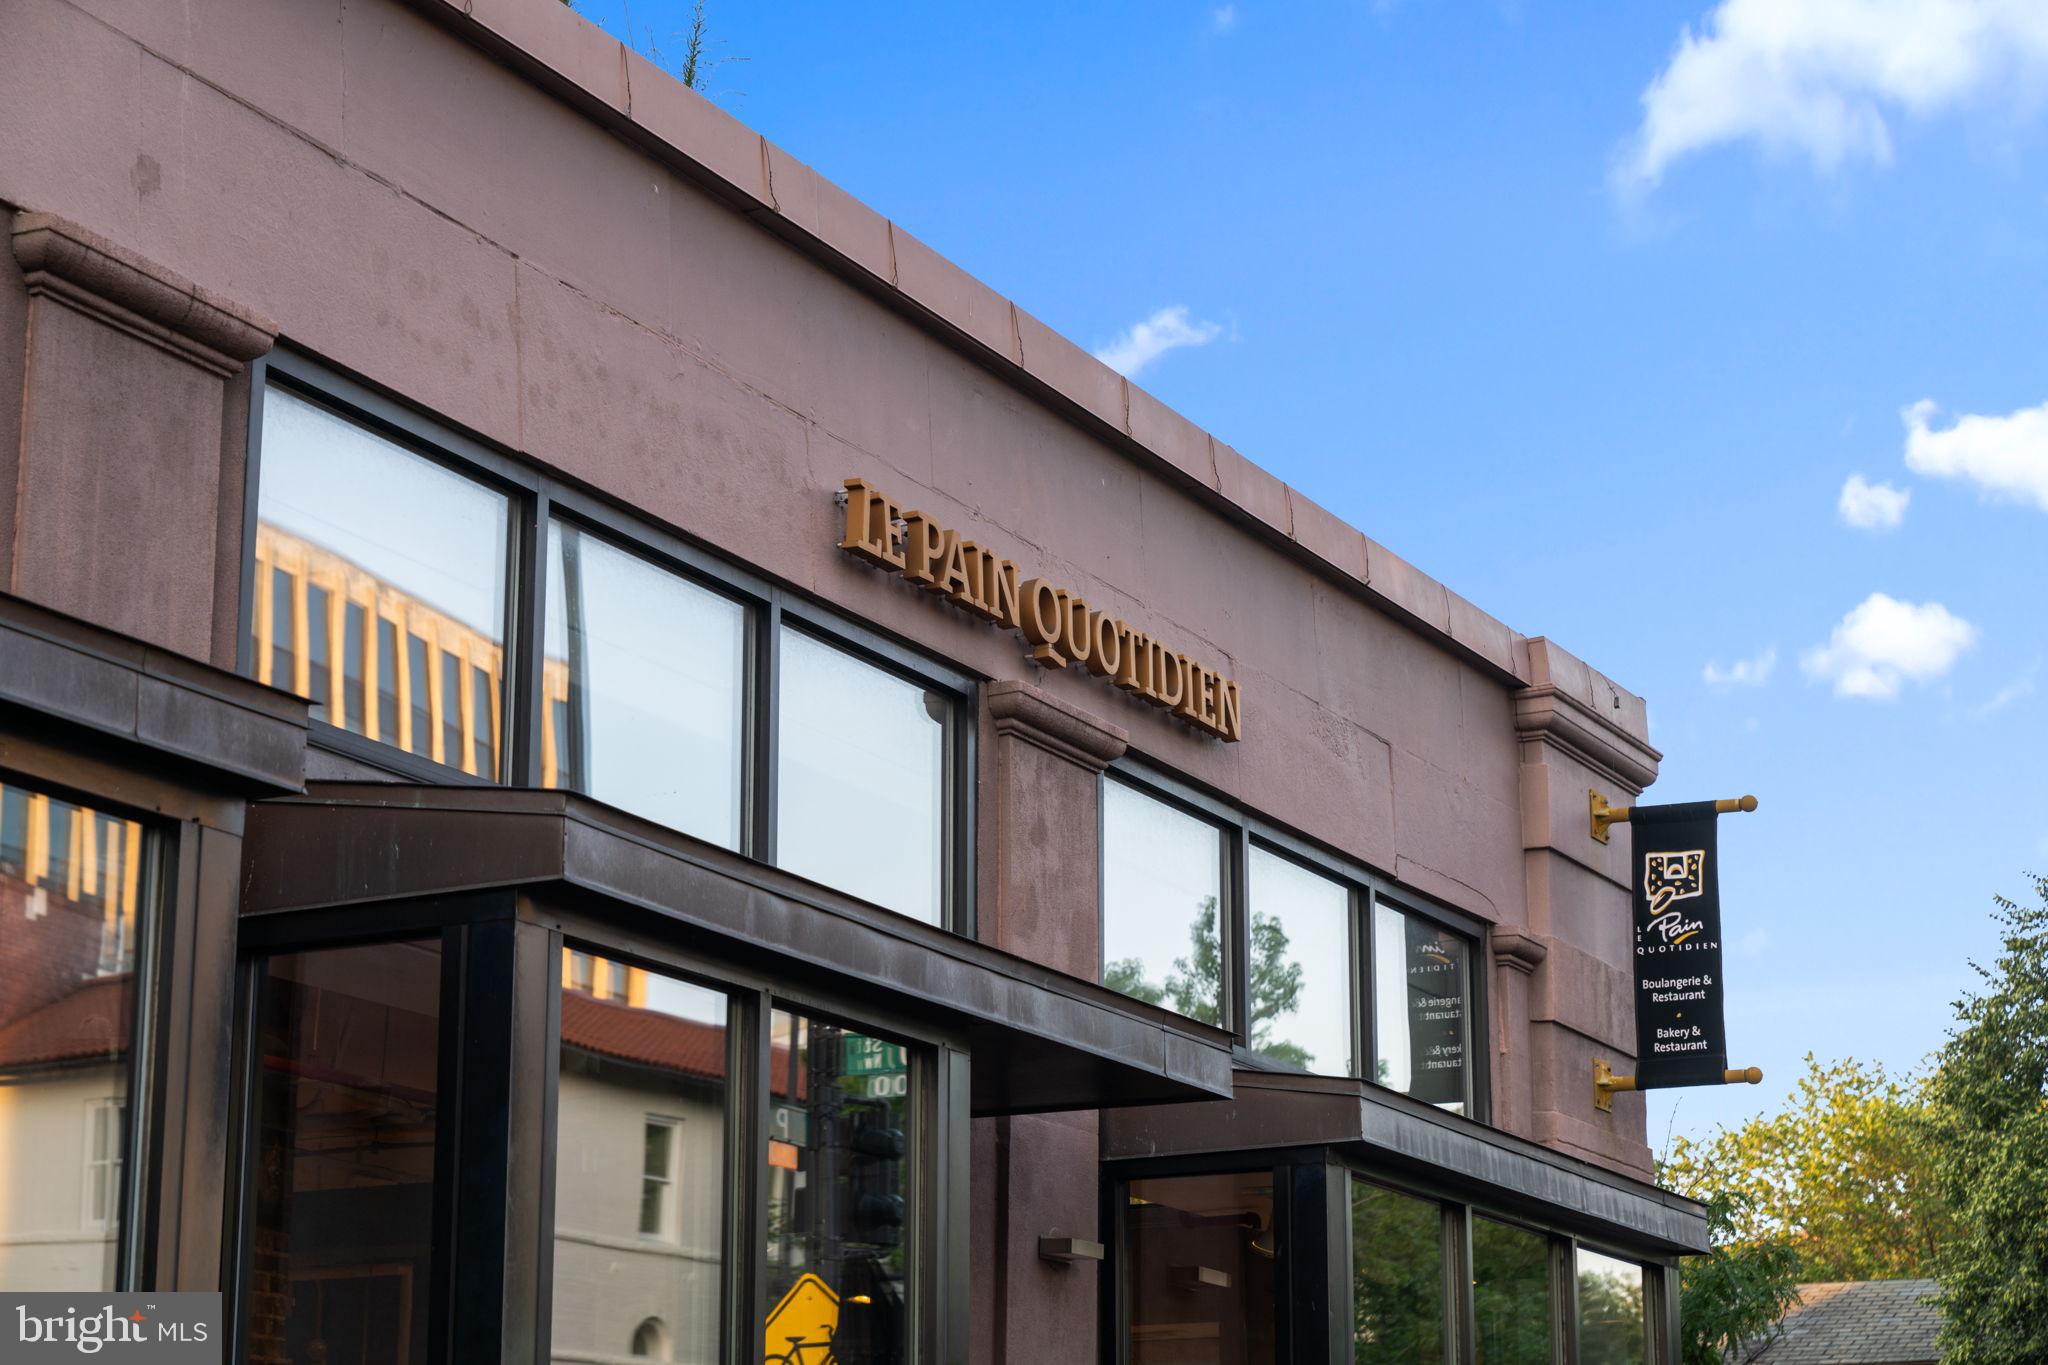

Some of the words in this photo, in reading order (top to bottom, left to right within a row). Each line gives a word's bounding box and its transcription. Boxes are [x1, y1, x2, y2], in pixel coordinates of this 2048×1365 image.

[843, 478, 906, 573] LE
[902, 510, 1020, 630] PAIN
[1018, 578, 1241, 743] QUOTIDIEN
[1647, 912, 1703, 942] Pain
[1637, 942, 1718, 955] QUOTIDIEN
[1642, 976, 1701, 990] Boulangerie
[1703, 974, 1712, 985] &
[1652, 990, 1706, 1002] Restaurant
[1657, 1027, 1690, 1040] Bakery
[1692, 1026, 1701, 1036] &
[1654, 1040, 1708, 1053] Restaurant
